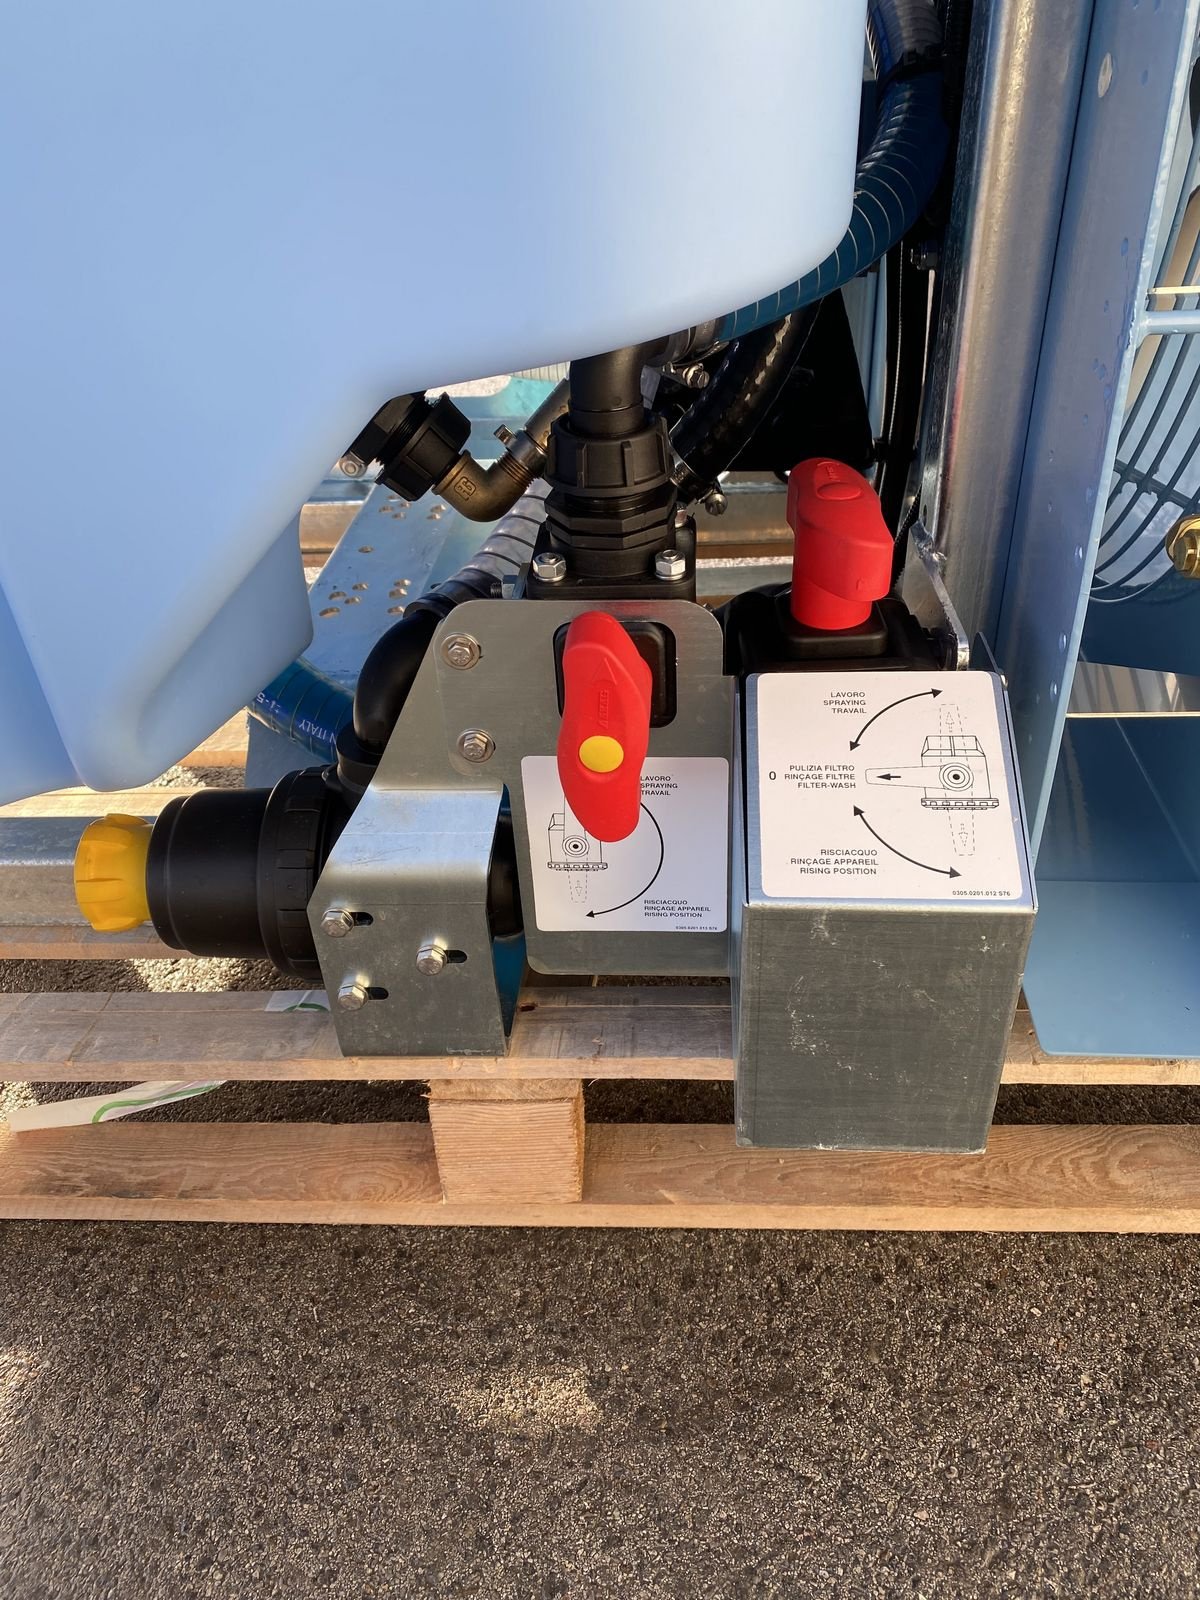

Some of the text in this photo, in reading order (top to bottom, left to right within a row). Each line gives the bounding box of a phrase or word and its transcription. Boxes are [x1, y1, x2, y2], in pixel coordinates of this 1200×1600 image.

[298, 719, 328, 741] ITALY
[789, 764, 855, 772] PULIZIA FILTRO
[825, 773, 856, 781] FILTRE
[797, 781, 856, 789] FILTER-WASH
[790, 858, 879, 866] RINÇAGE APPAREIL
[799, 867, 877, 875] RISING POSITION
